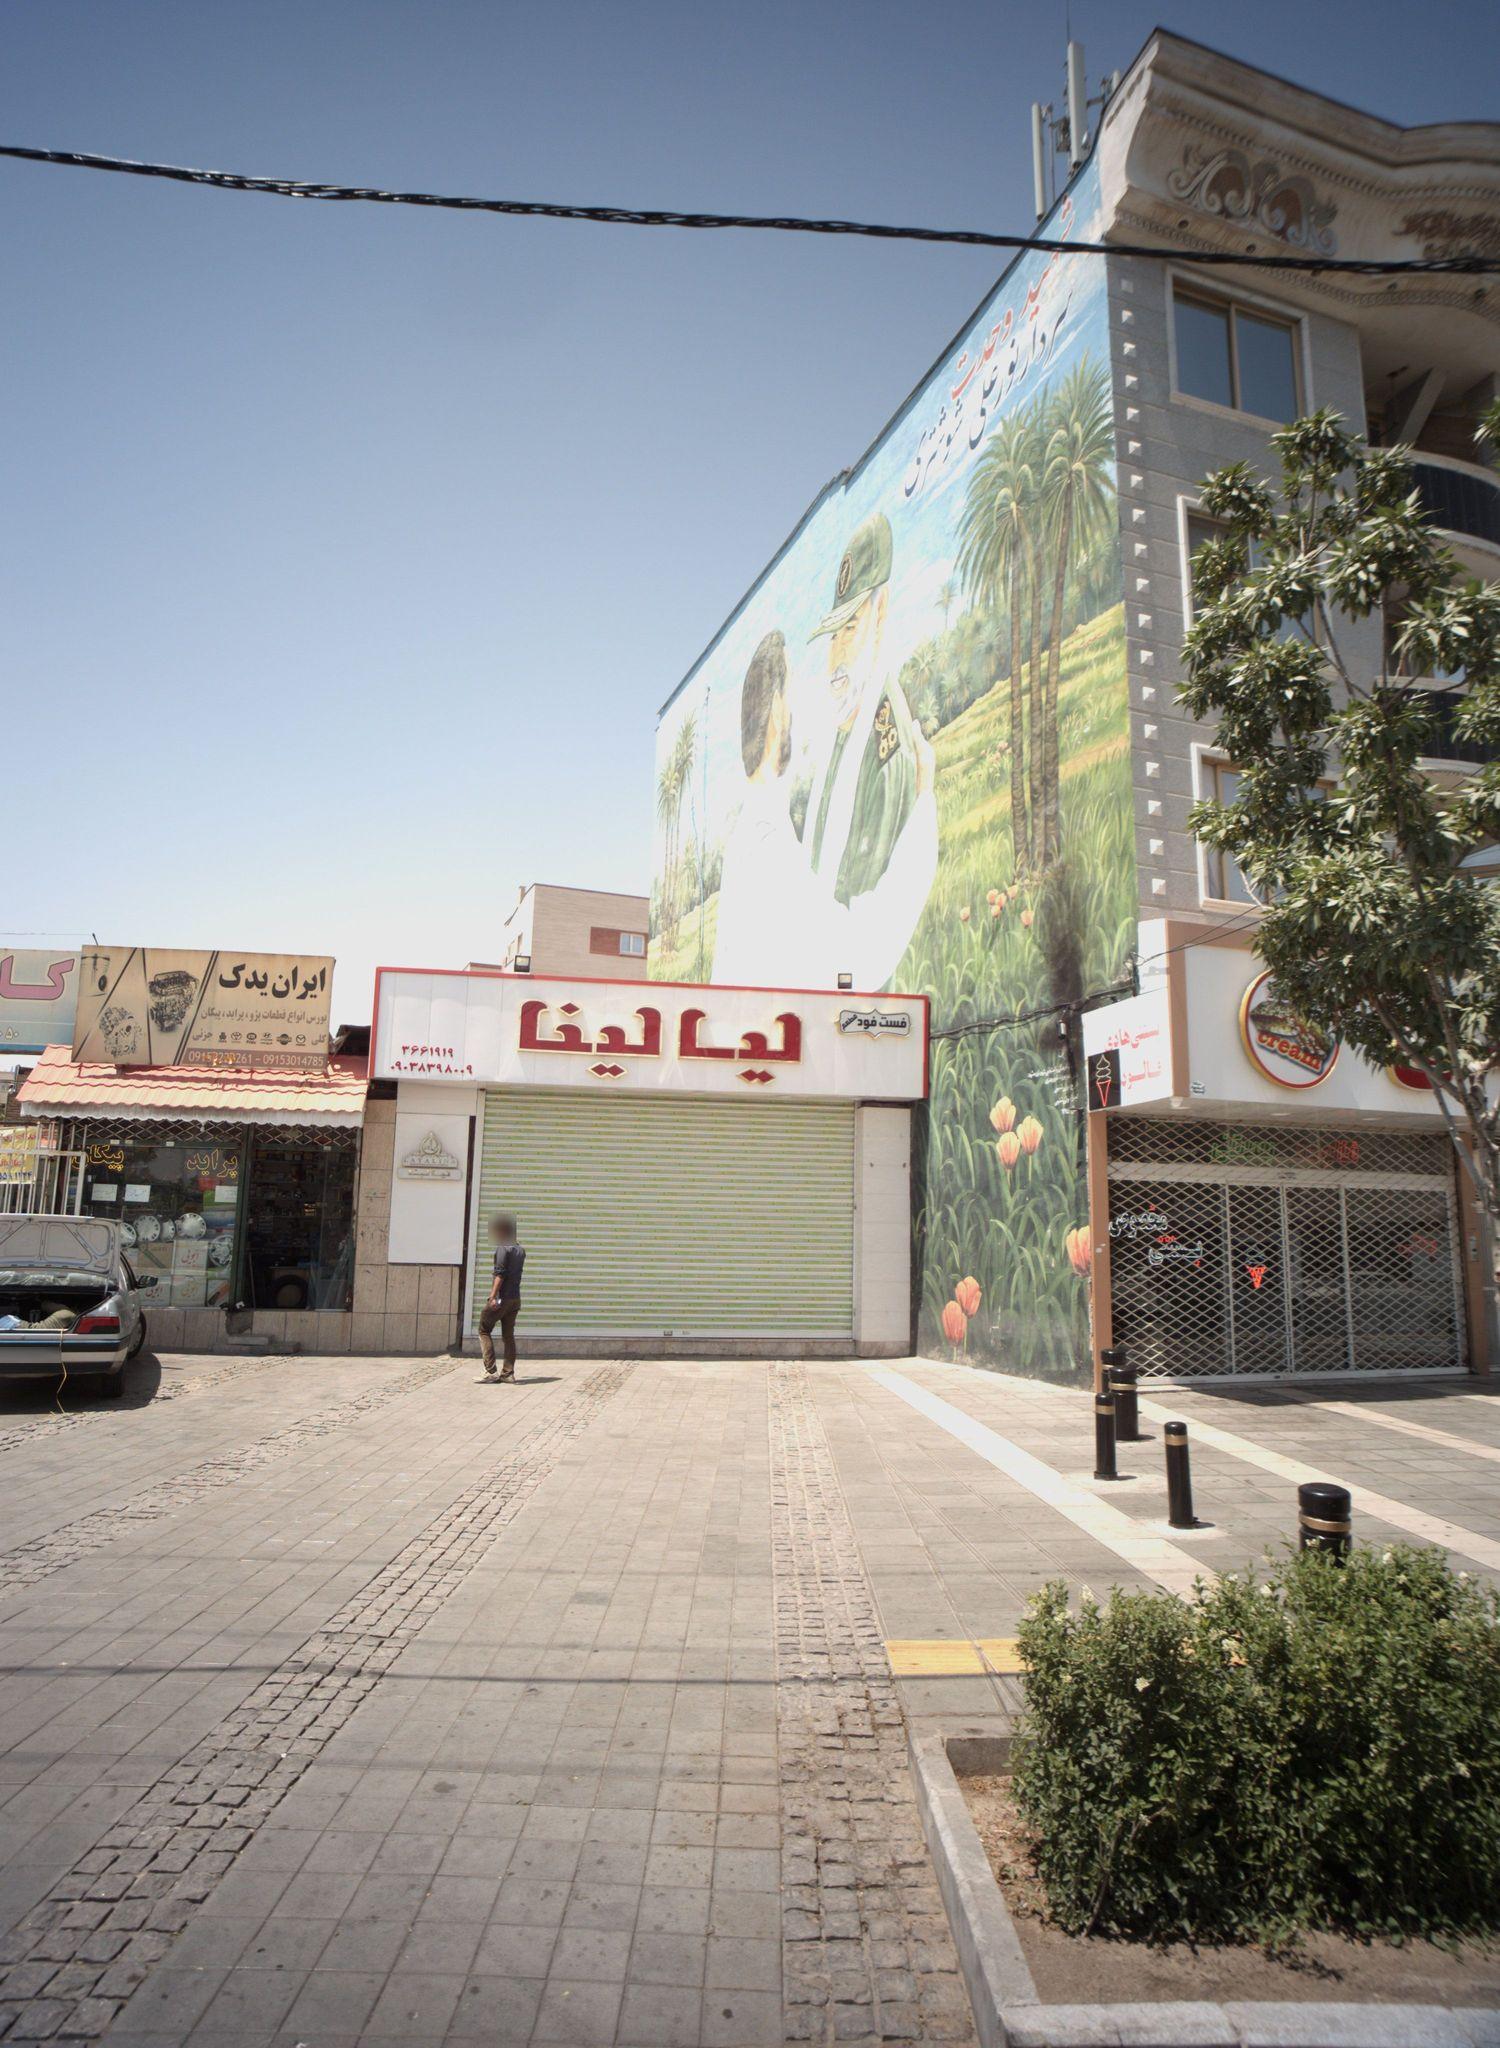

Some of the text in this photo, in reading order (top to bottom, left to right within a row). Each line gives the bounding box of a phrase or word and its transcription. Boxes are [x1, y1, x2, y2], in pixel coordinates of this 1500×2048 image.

[218, 963, 327, 1000] ایران یدک
[262, 1009, 286, 1021] قطعات
[287, 1011, 306, 1024] انواع
[878, 1016, 907, 1028] فست
[857, 1016, 877, 1030] فود
[401, 1045, 454, 1058] ۳۶۶۱۹۱۹
[1256, 1031, 1323, 1072] cream
[390, 1061, 473, 1075] ۰۹۰۳۸۳۹۸۰۰۹
[186, 1148, 238, 1178] پراید
